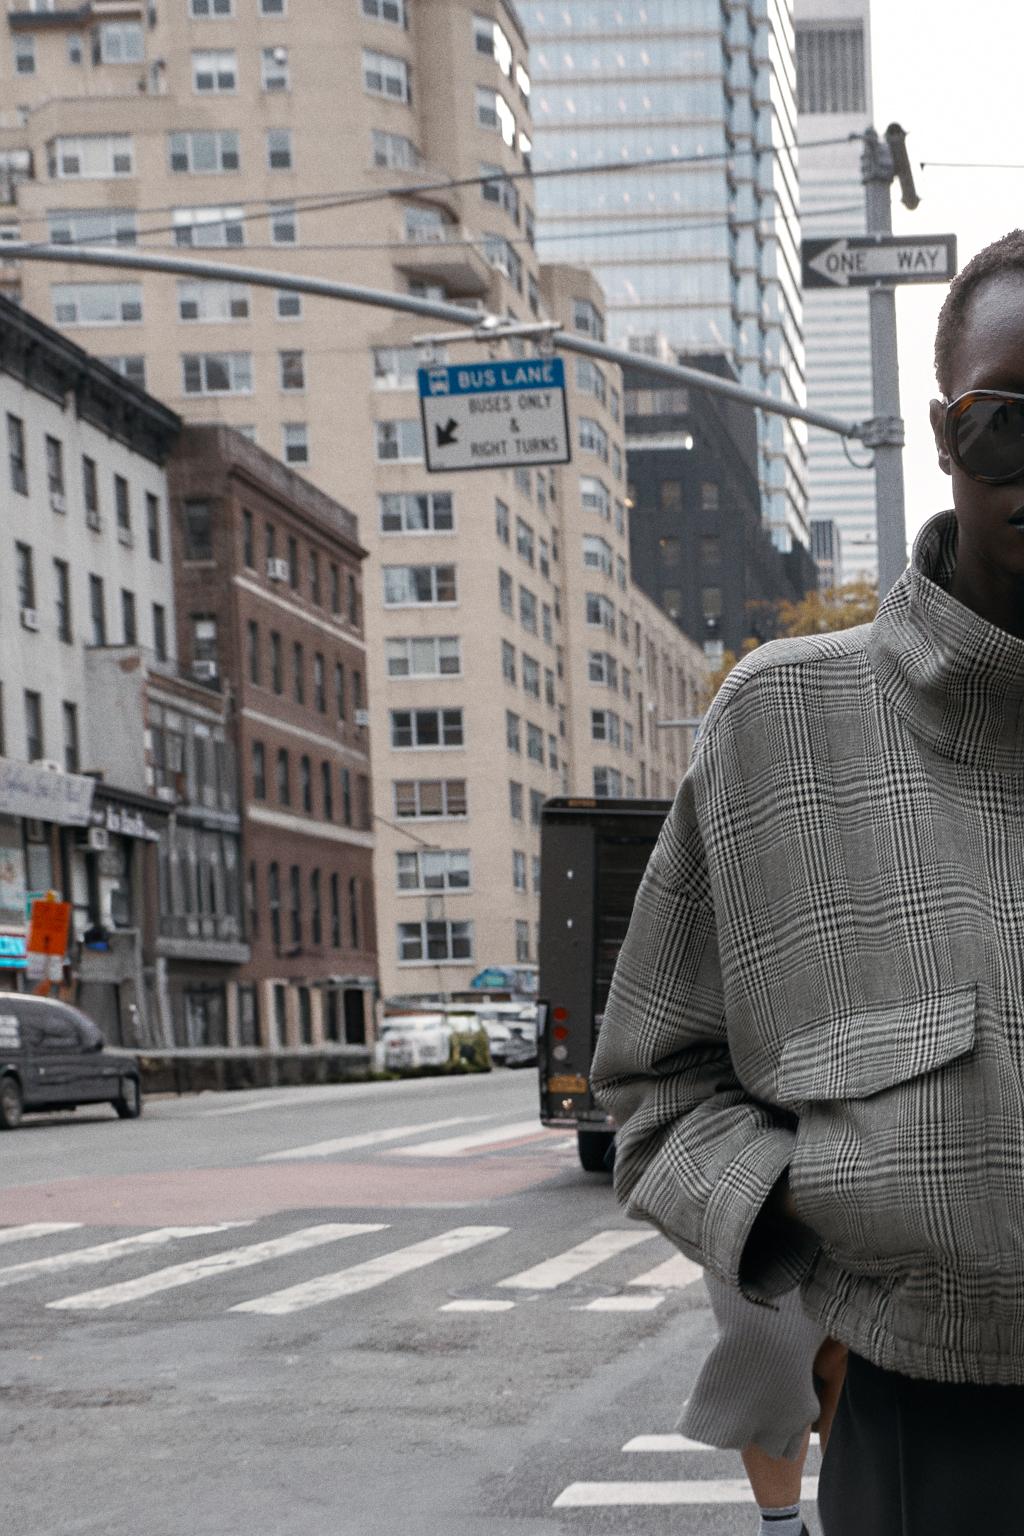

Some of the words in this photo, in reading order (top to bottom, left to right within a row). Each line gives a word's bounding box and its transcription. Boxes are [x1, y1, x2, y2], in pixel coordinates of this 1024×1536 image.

[826, 253, 866, 273] ONE
[897, 251, 939, 268] WAY
[457, 369, 496, 388] BUS
[501, 366, 554, 386] LANE
[468, 396, 511, 414] BUSES
[518, 393, 551, 410] ONLY
[510, 417, 520, 433] &
[470, 440, 507, 457] RIGHT
[515, 437, 558, 453] TURNS
